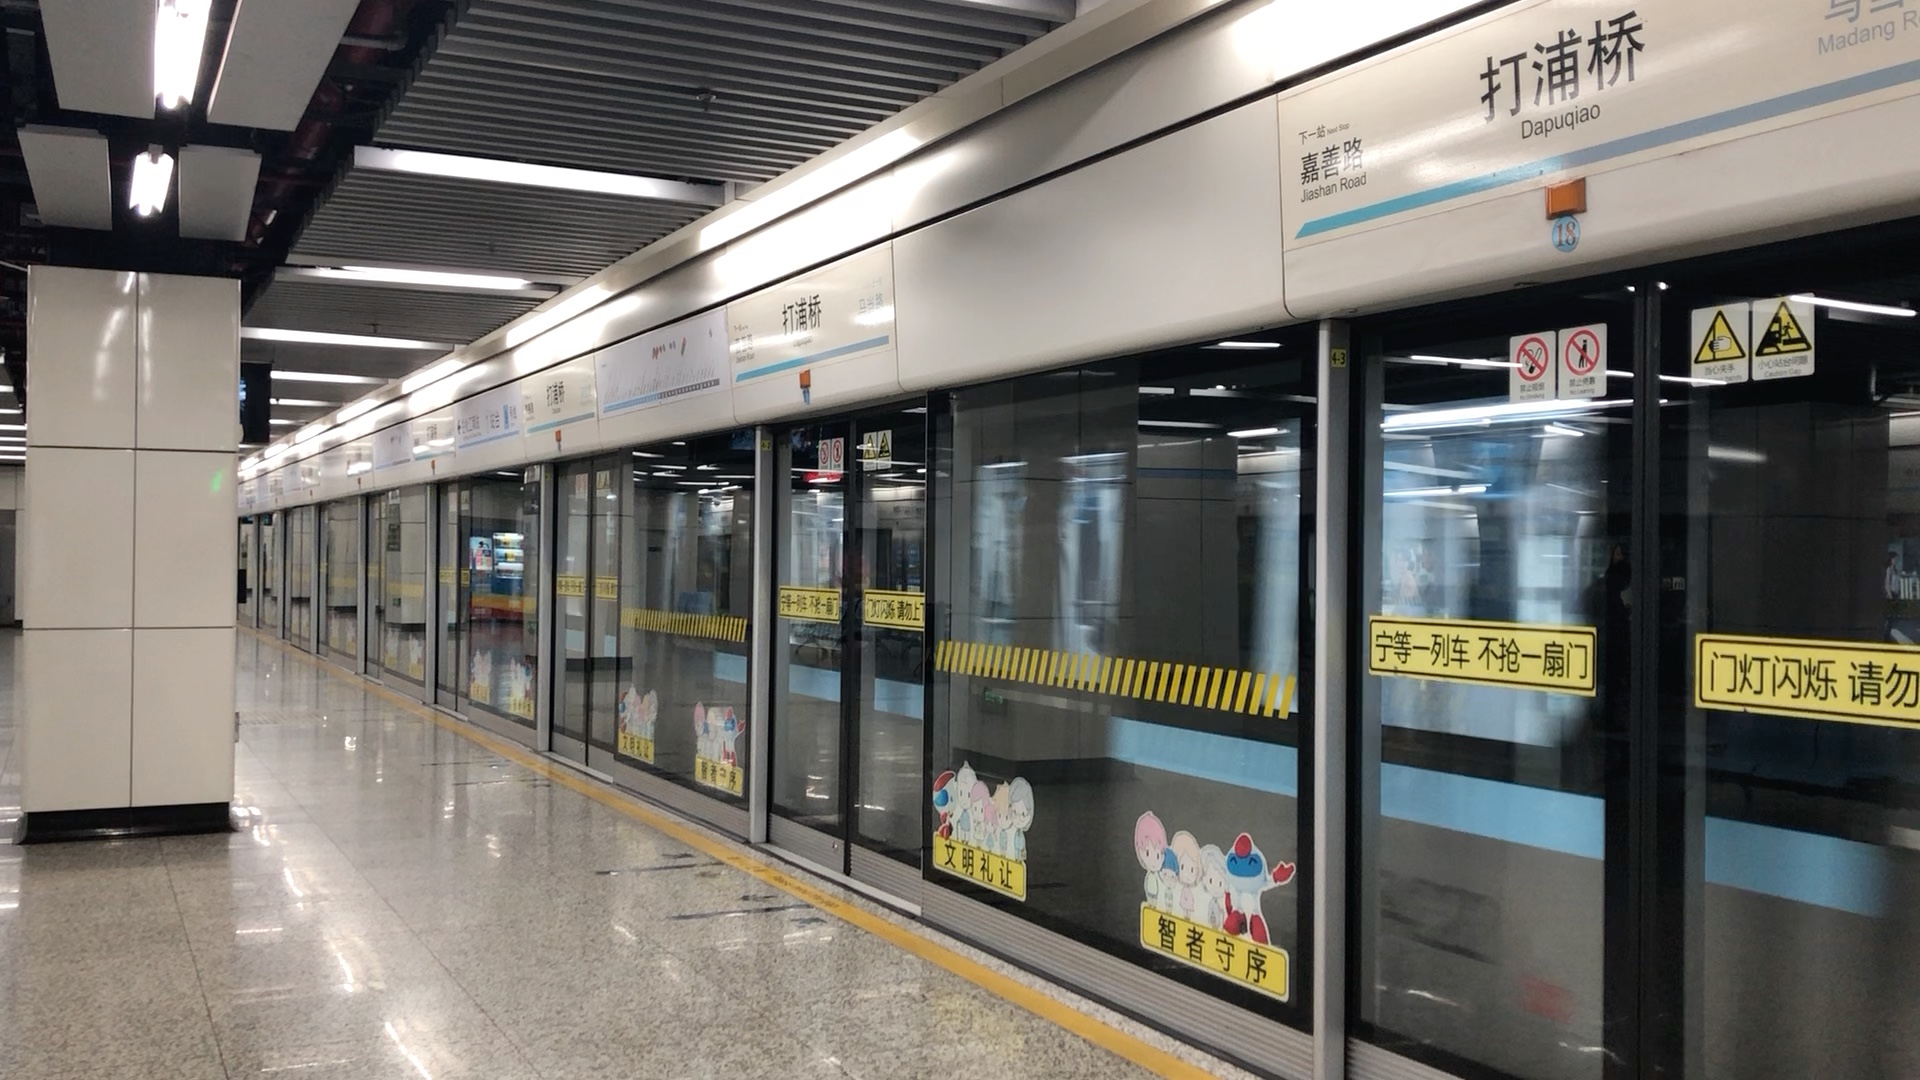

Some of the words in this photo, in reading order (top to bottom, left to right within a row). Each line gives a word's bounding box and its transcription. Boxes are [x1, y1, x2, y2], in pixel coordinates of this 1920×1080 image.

[1818, 21, 1895, 55] Madang
[1903, 10, 1920, 31] R
[1480, 10, 1645, 124] 打浦桥
[1298, 124, 1326, 145] 下一站
[1521, 104, 1601, 139] Dapuqiao
[1300, 137, 1363, 185] 嘉善路
[1300, 183, 1338, 203] Jiashan
[1340, 171, 1367, 191] Road
[1556, 221, 1576, 247] 18
[782, 294, 822, 336] 打浦桥
[1332, 351, 1346, 366] 4-3
[1375, 630, 1470, 669] 宁等一列车
[1477, 636, 1588, 680] 不抢一扇门
[1710, 651, 1838, 701] 门灯闪烁
[1848, 660, 1920, 708] 请勿
[943, 841, 1014, 891] 文明礼让
[1156, 914, 1268, 984] 智者守序
